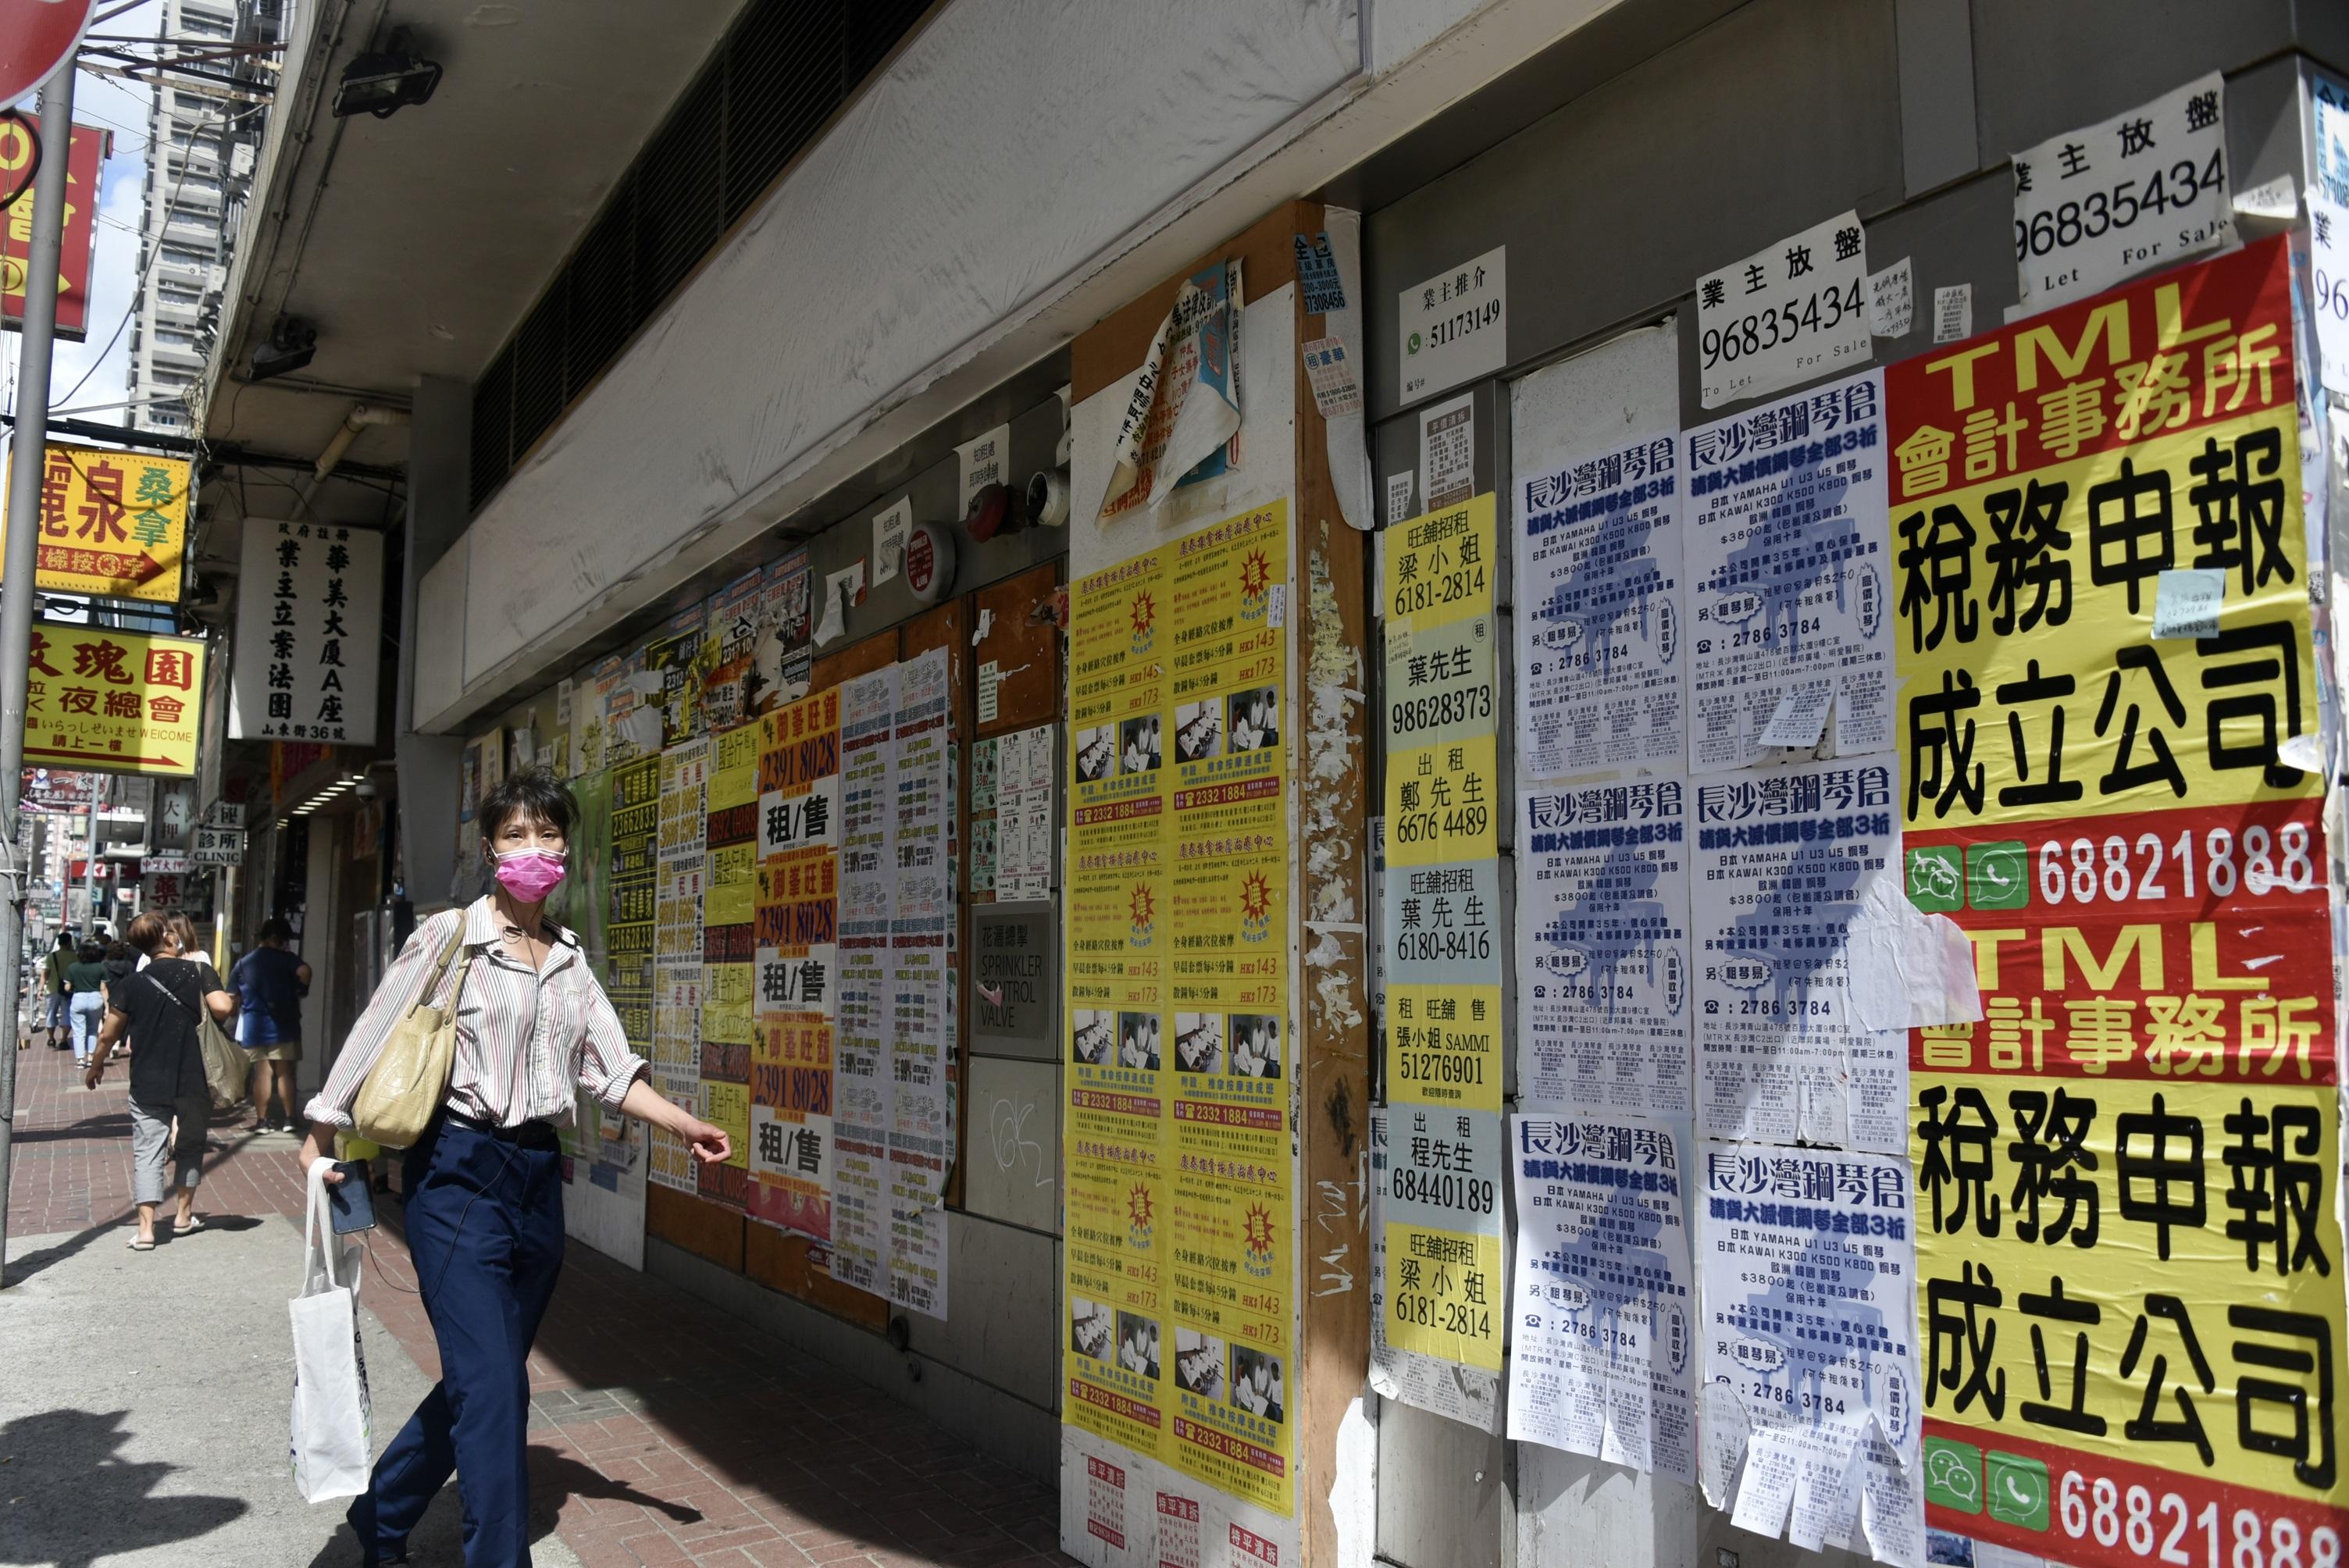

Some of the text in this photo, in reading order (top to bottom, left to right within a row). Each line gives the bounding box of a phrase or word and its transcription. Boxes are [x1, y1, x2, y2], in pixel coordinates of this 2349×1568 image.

[1701, 226, 1862, 311] 業主放盤
[2044, 217, 2229, 291] Let For Sale
[1422, 265, 1486, 312] 業主推介
[1702, 276, 1865, 370] 96835434
[1702, 337, 1867, 398] To Let For Sale
[1925, 281, 2232, 412] TML
[1689, 380, 1877, 472] 長沙灣鋼琴倉
[1894, 322, 2282, 497] 會計事務所
[1526, 437, 1675, 513] 長沙灣鋼琴倉
[131, 466, 174, 547] 桑拿
[1407, 510, 1470, 550] 旺舖招租
[1898, 426, 2296, 654] 稅務申報
[1399, 533, 1481, 586] 梁小姐
[1395, 565, 1485, 616] 6181-2814
[1718, 597, 1755, 617] 租琴易
[1862, 575, 1873, 626] 高價收琴
[1474, 623, 1485, 638] 租
[1733, 617, 1820, 647] 2786 3784
[1408, 644, 1472, 688] 葉先生
[1559, 644, 1628, 670] 2786 3784
[59, 686, 186, 723] 夜總會
[1392, 684, 1491, 734] 98628373
[1905, 619, 2306, 822] 成立公司
[763, 732, 836, 792] 2391 8028
[1417, 747, 1464, 776] 出租
[1196, 784, 1246, 803] 2332 1884
[1400, 772, 1485, 813] 鄭先生
[1527, 781, 1683, 830] 長沙灣鋼琴倉
[1697, 766, 1890, 823] 長沙灣鋼琴倉
[198, 832, 237, 849] 診所
[766, 794, 829, 846] 租/售
[1397, 806, 1488, 843] 6676 4489
[194, 852, 239, 862] CLINIC
[2038, 825, 2315, 905] 68821888
[1410, 868, 1474, 895] 旺舖招租
[760, 899, 832, 946] 2391 8028
[1401, 895, 1485, 930] 葉先生
[982, 955, 1042, 977] SPRINKLER
[1397, 930, 1490, 961] 6180-8416
[1964, 921, 2271, 992] TML
[762, 960, 825, 1003] 租/售
[1563, 985, 1634, 1000] 2786 3784
[981, 1004, 1014, 1028] VALVE
[1399, 998, 1486, 1021] 租 旺舖 售
[1741, 1000, 1831, 1015] 2786 3784
[1396, 1026, 1490, 1053] 張小姐 SAMMI
[1920, 993, 2322, 1081] 會計事務所
[755, 1064, 828, 1114] 2391 8028
[1401, 1053, 1484, 1085] 51276901
[1196, 1104, 1248, 1124] 2332 1884
[1413, 1112, 1471, 1139] 出租
[757, 1121, 822, 1174] 租/售
[1410, 1136, 1474, 1174] 程先生
[1520, 1120, 1676, 1171] 長沙灣鋼琴倉
[1392, 1167, 1493, 1215] 68440189
[1707, 1153, 1905, 1210] 長沙灣鋼琴倉
[1916, 1084, 2331, 1278] 稅務申報
[1410, 1233, 1475, 1267] 旺舖招租
[1717, 1241, 1901, 1276] 日本 KAWAI K300 K500 K800 鋼琴
[1731, 1228, 1884, 1258] 日本 YAMAHA U1 U3 U5 鋼琴
[1400, 1257, 1487, 1306] 梁小姐
[1741, 1273, 1795, 1289] $3800起
[1770, 1262, 1841, 1282] 歐洲 韓國 鋼琴
[1395, 1292, 1491, 1341] 6181-2814
[1786, 1292, 1827, 1309] 保用十年
[1562, 1319, 1637, 1348] 2786 3784
[1924, 1259, 2337, 1491] 成立公司
[1753, 1382, 1845, 1415] 2786 3784
[2059, 1469, 2342, 1568] 68821888
